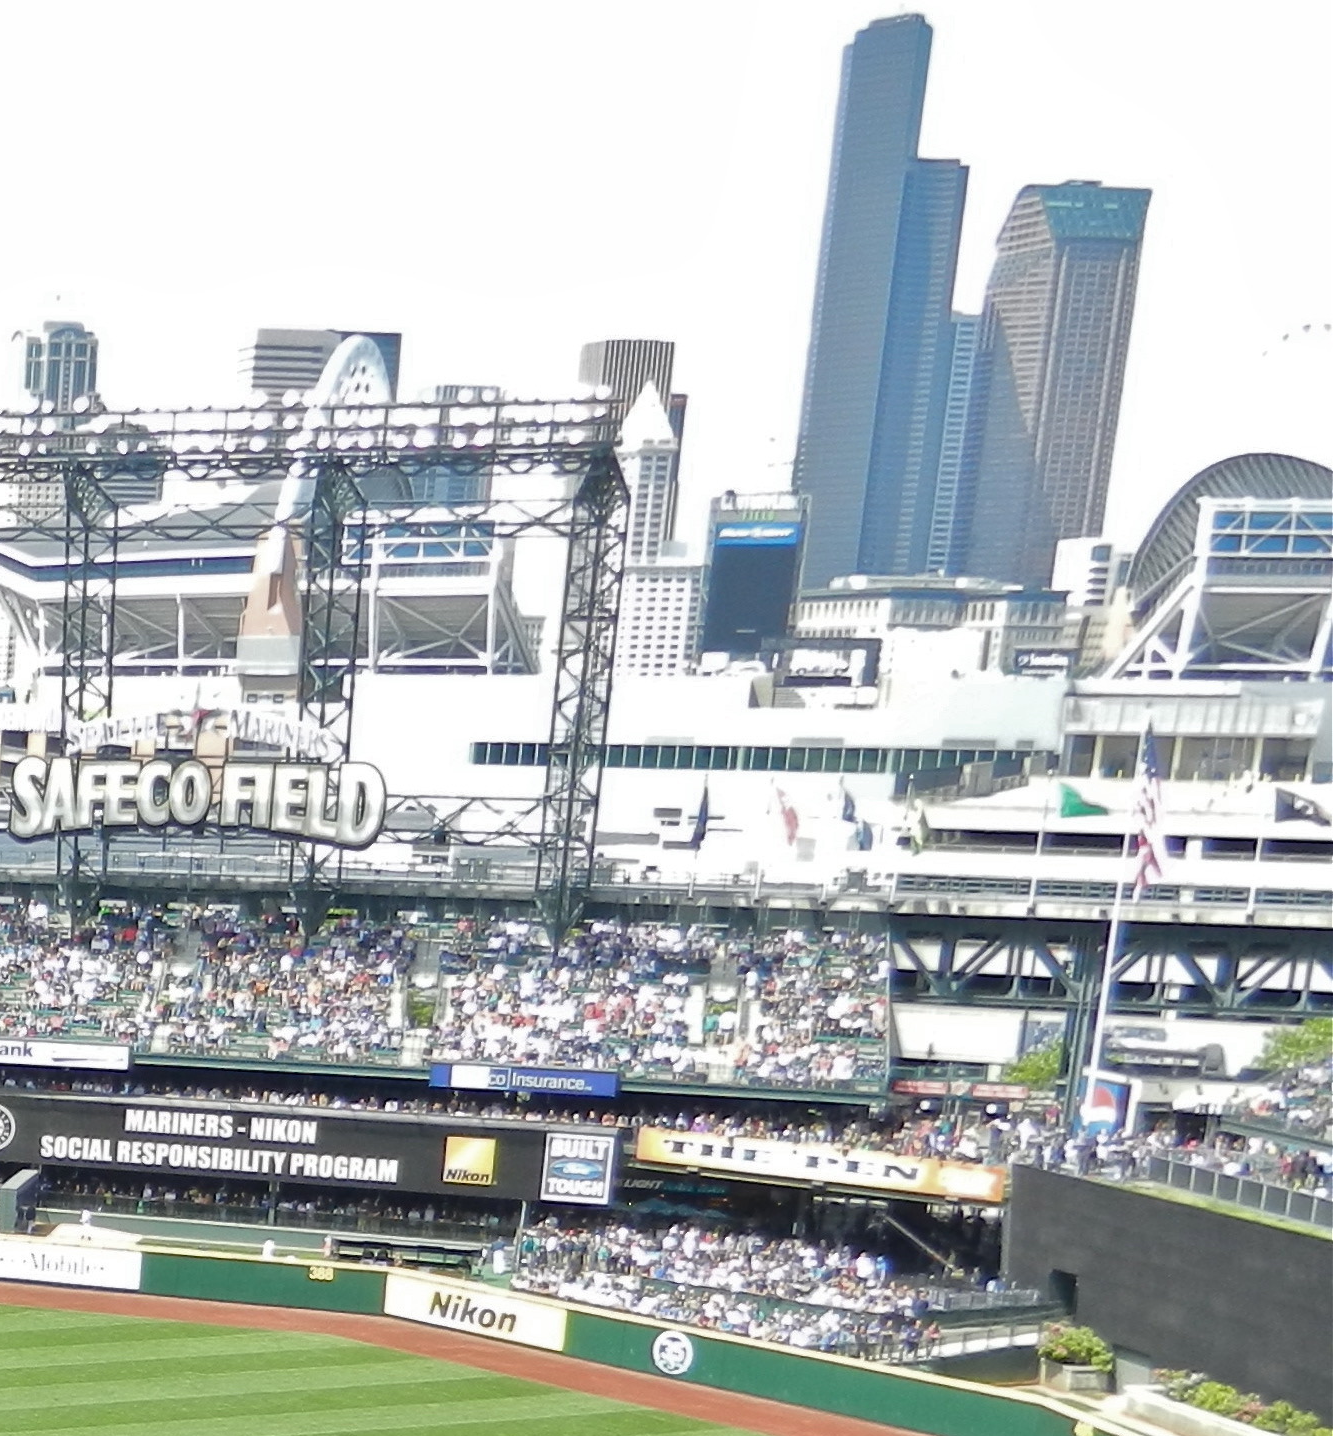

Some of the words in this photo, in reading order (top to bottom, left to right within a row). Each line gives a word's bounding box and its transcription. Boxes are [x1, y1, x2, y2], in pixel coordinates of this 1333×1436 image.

[10, 755, 212, 840] SAFECO
[220, 760, 387, 850] FIELD
[512, 1072, 585, 1091] Insurance
[124, 1108, 233, 1139] MARINERS
[249, 1117, 318, 1144] NIKON
[41, 1135, 113, 1162] SOCIAL
[117, 1140, 286, 1175] RESPONSIBILITY
[289, 1153, 398, 1184] PROGRAM
[550, 1137, 609, 1161] BUILT
[445, 1168, 490, 1184] Nikon
[547, 1177, 604, 1198] TOUGH
[624, 1178, 664, 1190] LIGHT
[429, 1291, 518, 1334] Nikon
